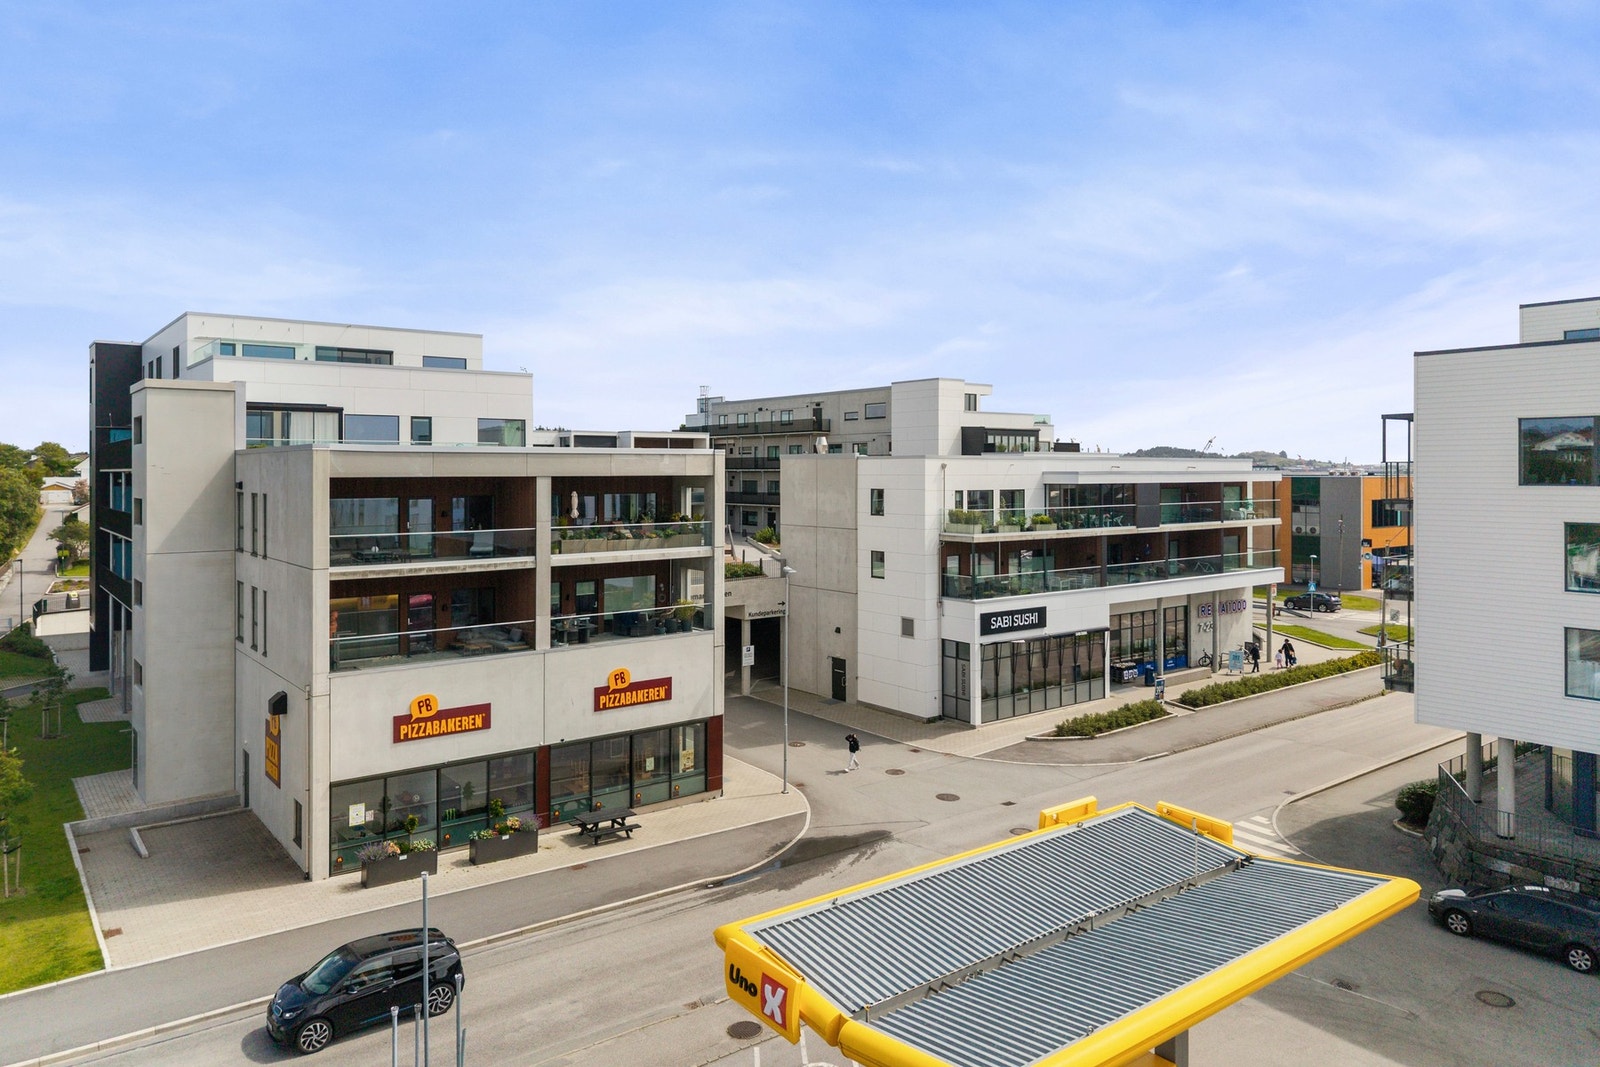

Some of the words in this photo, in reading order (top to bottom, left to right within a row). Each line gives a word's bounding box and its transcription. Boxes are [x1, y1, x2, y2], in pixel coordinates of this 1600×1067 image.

[1199, 602, 1226, 617] REA
[990, 615, 1013, 629] SABI
[1013, 612, 1038, 627] SUSHI
[614, 671, 626, 686] PB
[417, 698, 432, 714] PB
[600, 686, 665, 709] PIZZABAKEREN
[400, 714, 483, 740] PIZZABAKEREN
[729, 963, 758, 997] Uno
[763, 983, 786, 1025] X
